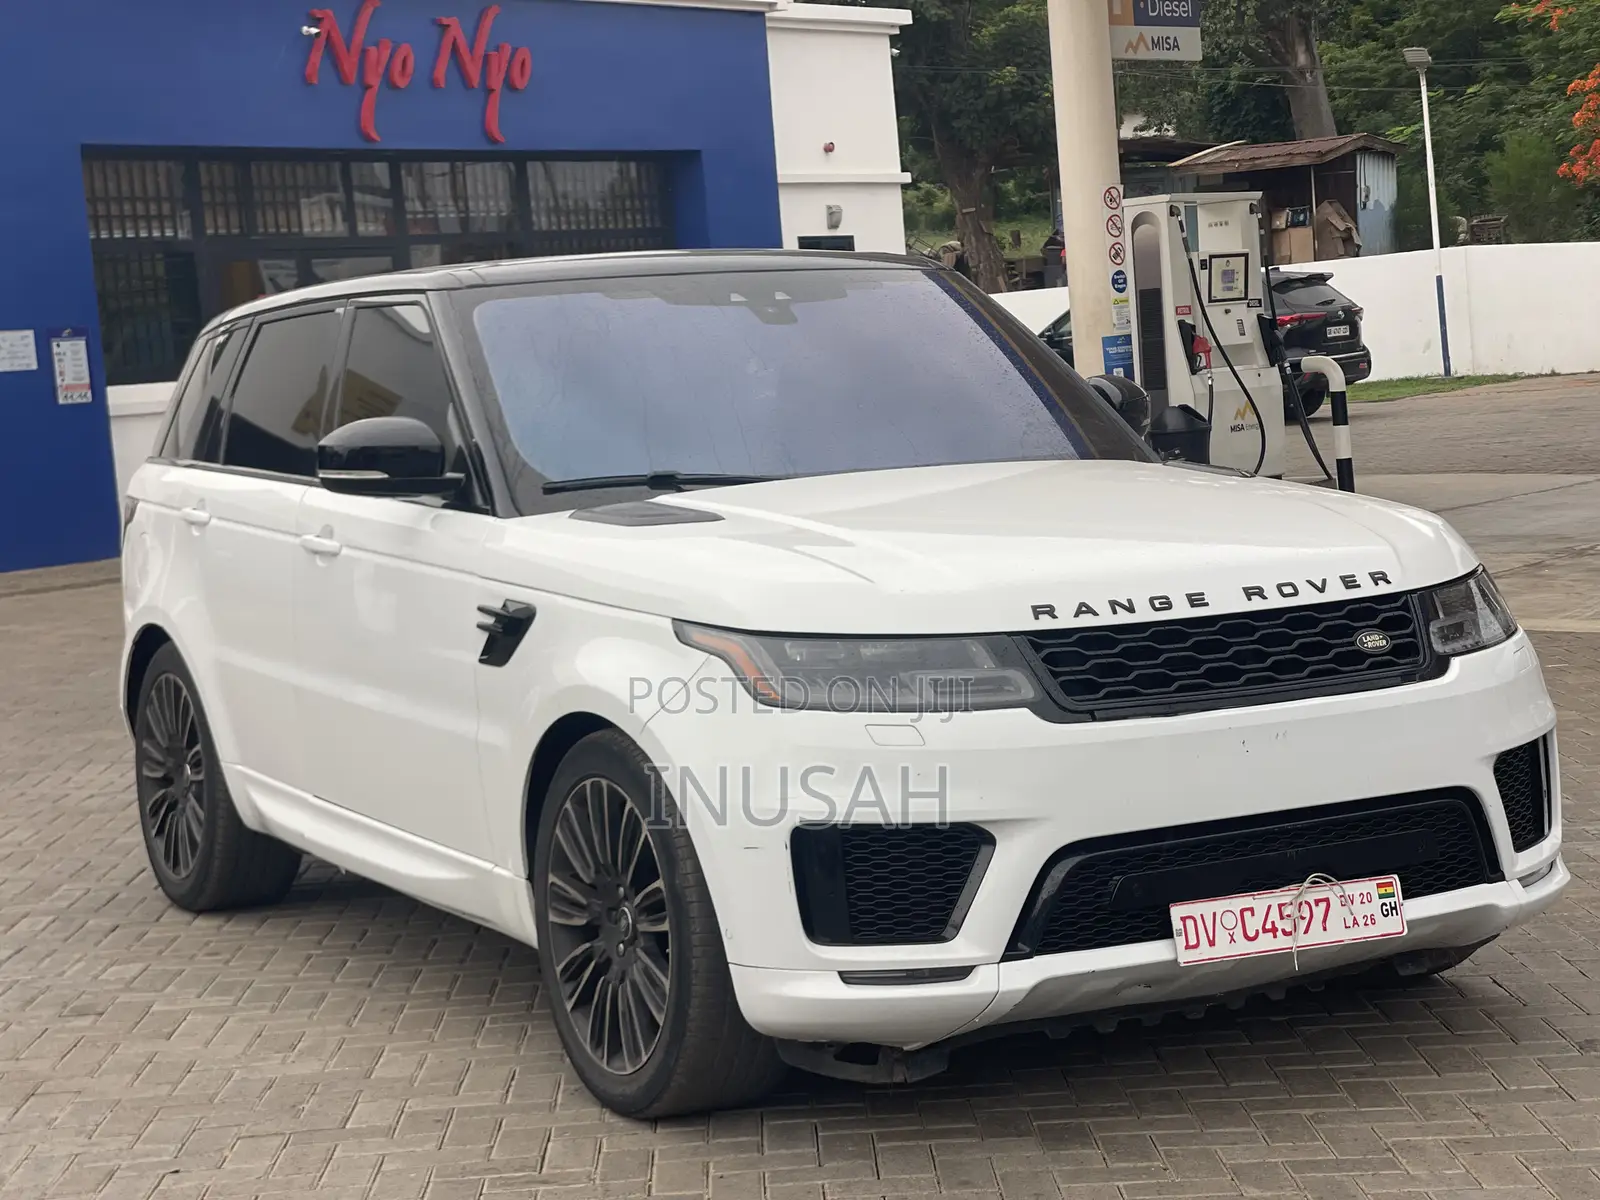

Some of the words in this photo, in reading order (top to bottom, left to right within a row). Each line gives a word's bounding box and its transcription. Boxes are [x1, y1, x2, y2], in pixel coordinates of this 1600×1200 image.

[1147, 0, 1192, 17] Diesel
[1150, 35, 1181, 52] MISA
[305, 0, 415, 142] Nyo
[432, 4, 532, 143] Nyo
[1230, 423, 1245, 433] MISA
[1245, 423, 1259, 431] Energ
[1031, 591, 1210, 620] RANGE
[1241, 570, 1393, 602] ROVER
[1362, 634, 1380, 643] LAND
[1367, 639, 1387, 648] ROVER
[1339, 893, 1356, 907] DV
[1358, 891, 1373, 905] 20
[1380, 900, 1399, 918] GH
[1180, 911, 1217, 950] DV
[1239, 897, 1330, 942] C4597
[1343, 915, 1360, 929] LA
[1362, 913, 1377, 927] 26
